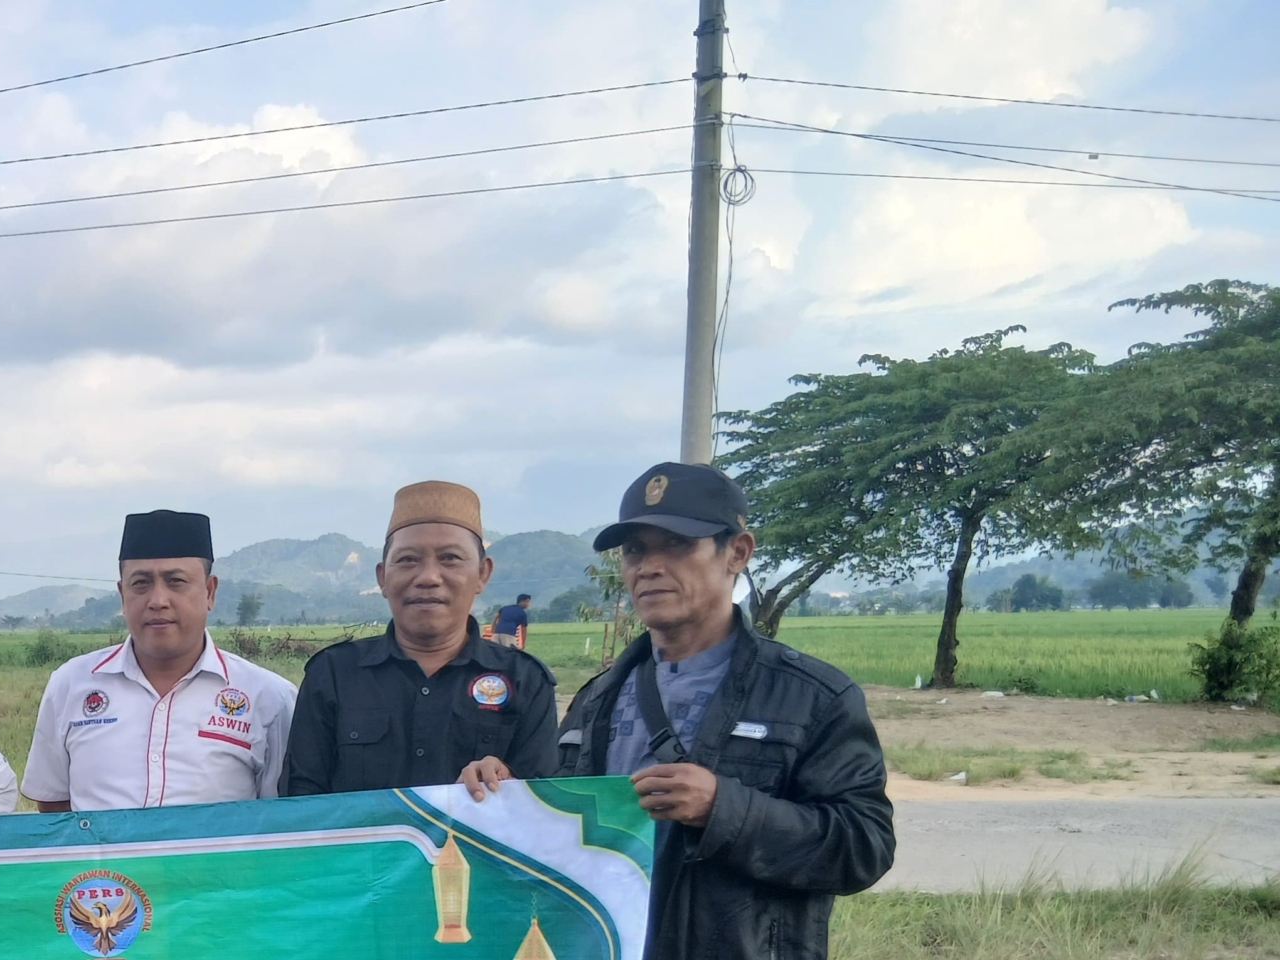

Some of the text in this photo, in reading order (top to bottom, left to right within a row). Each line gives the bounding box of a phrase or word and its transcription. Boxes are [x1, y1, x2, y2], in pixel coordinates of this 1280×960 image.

[207, 715, 252, 734] ASWIN
[54, 870, 154, 934] ASOSIASI WARTAWAN INTERNASIONAL
[76, 888, 125, 900] PERS
